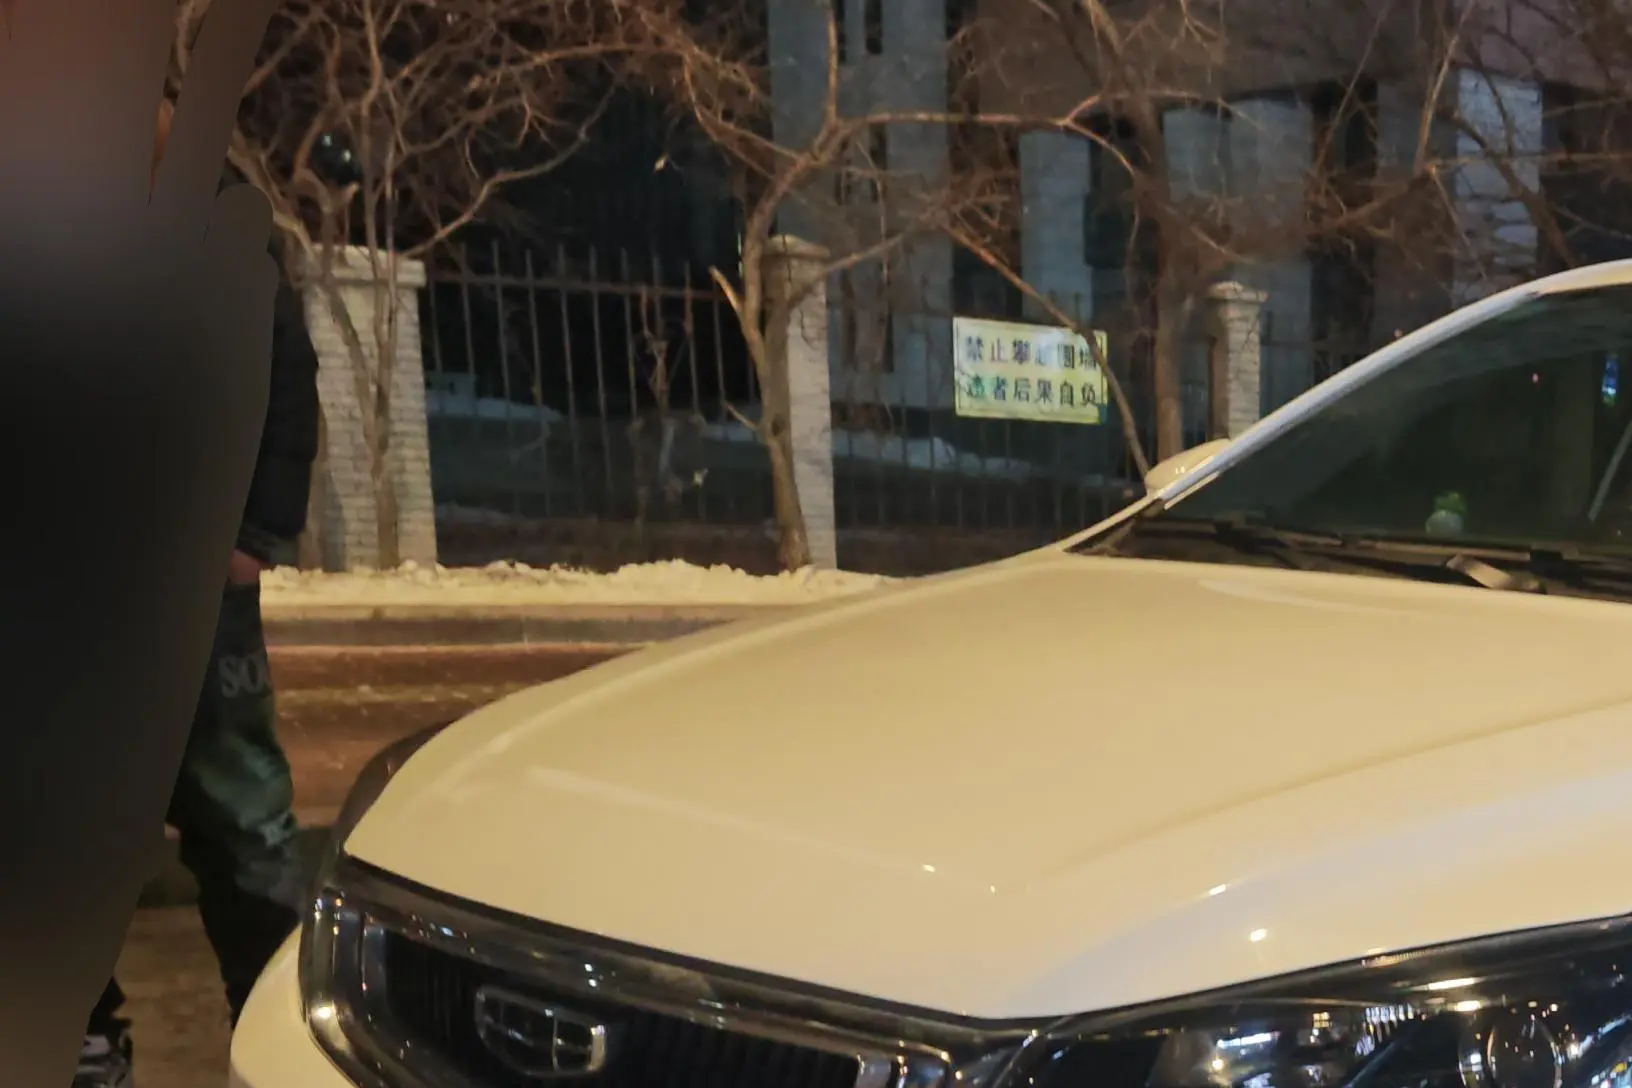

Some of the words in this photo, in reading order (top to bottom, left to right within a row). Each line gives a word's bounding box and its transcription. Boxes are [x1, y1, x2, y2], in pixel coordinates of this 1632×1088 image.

[968, 374, 1097, 407] 违者后果自负
